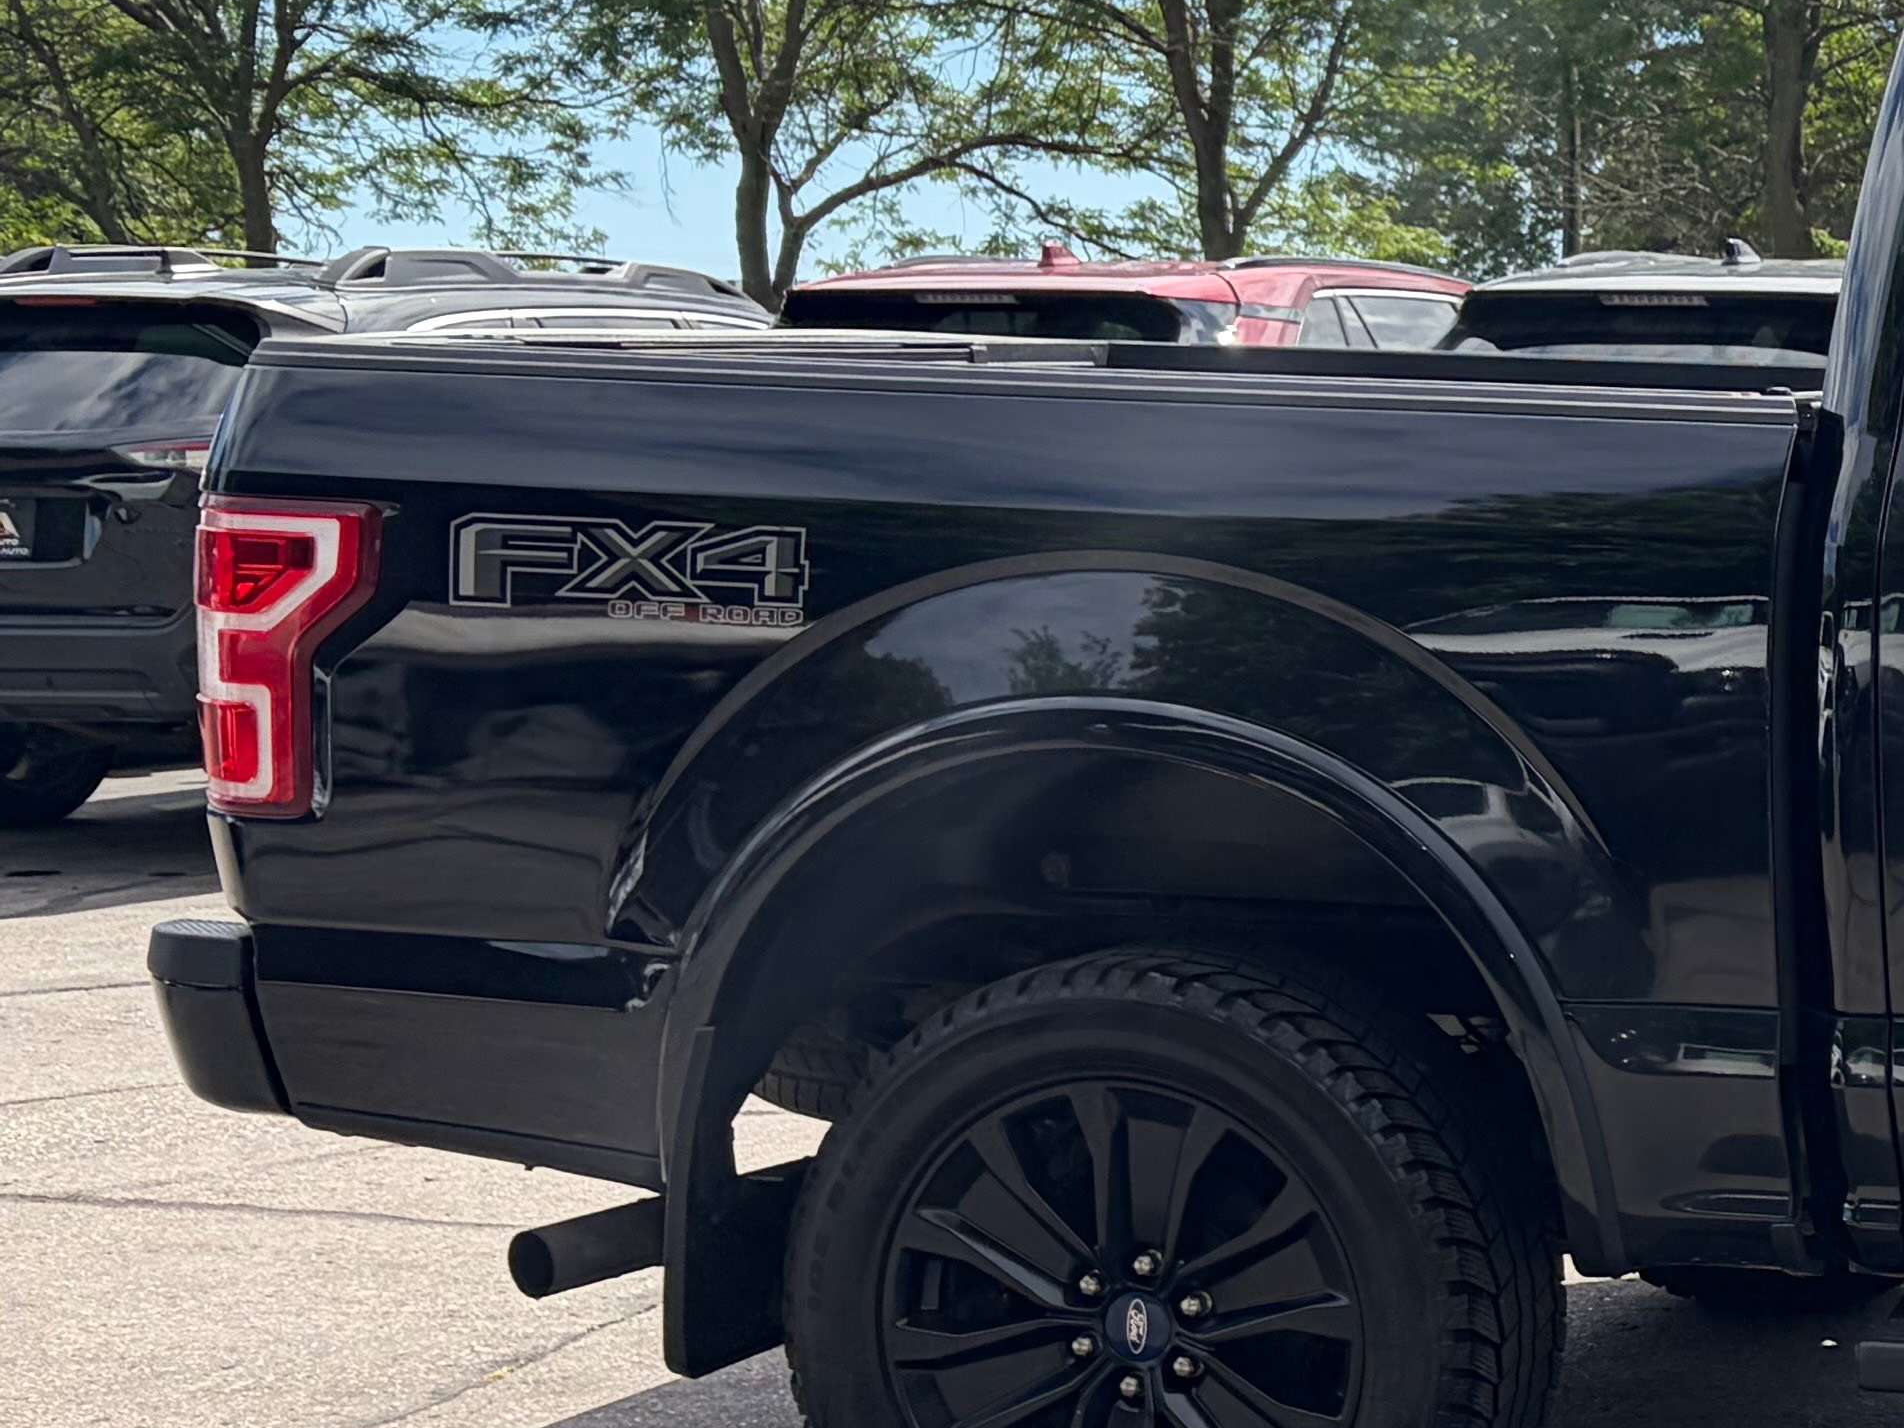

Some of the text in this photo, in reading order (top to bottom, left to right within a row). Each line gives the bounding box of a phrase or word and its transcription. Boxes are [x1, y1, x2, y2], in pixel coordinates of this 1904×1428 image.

[448, 511, 810, 608] FX4
[607, 600, 805, 627] OFF ROAD
